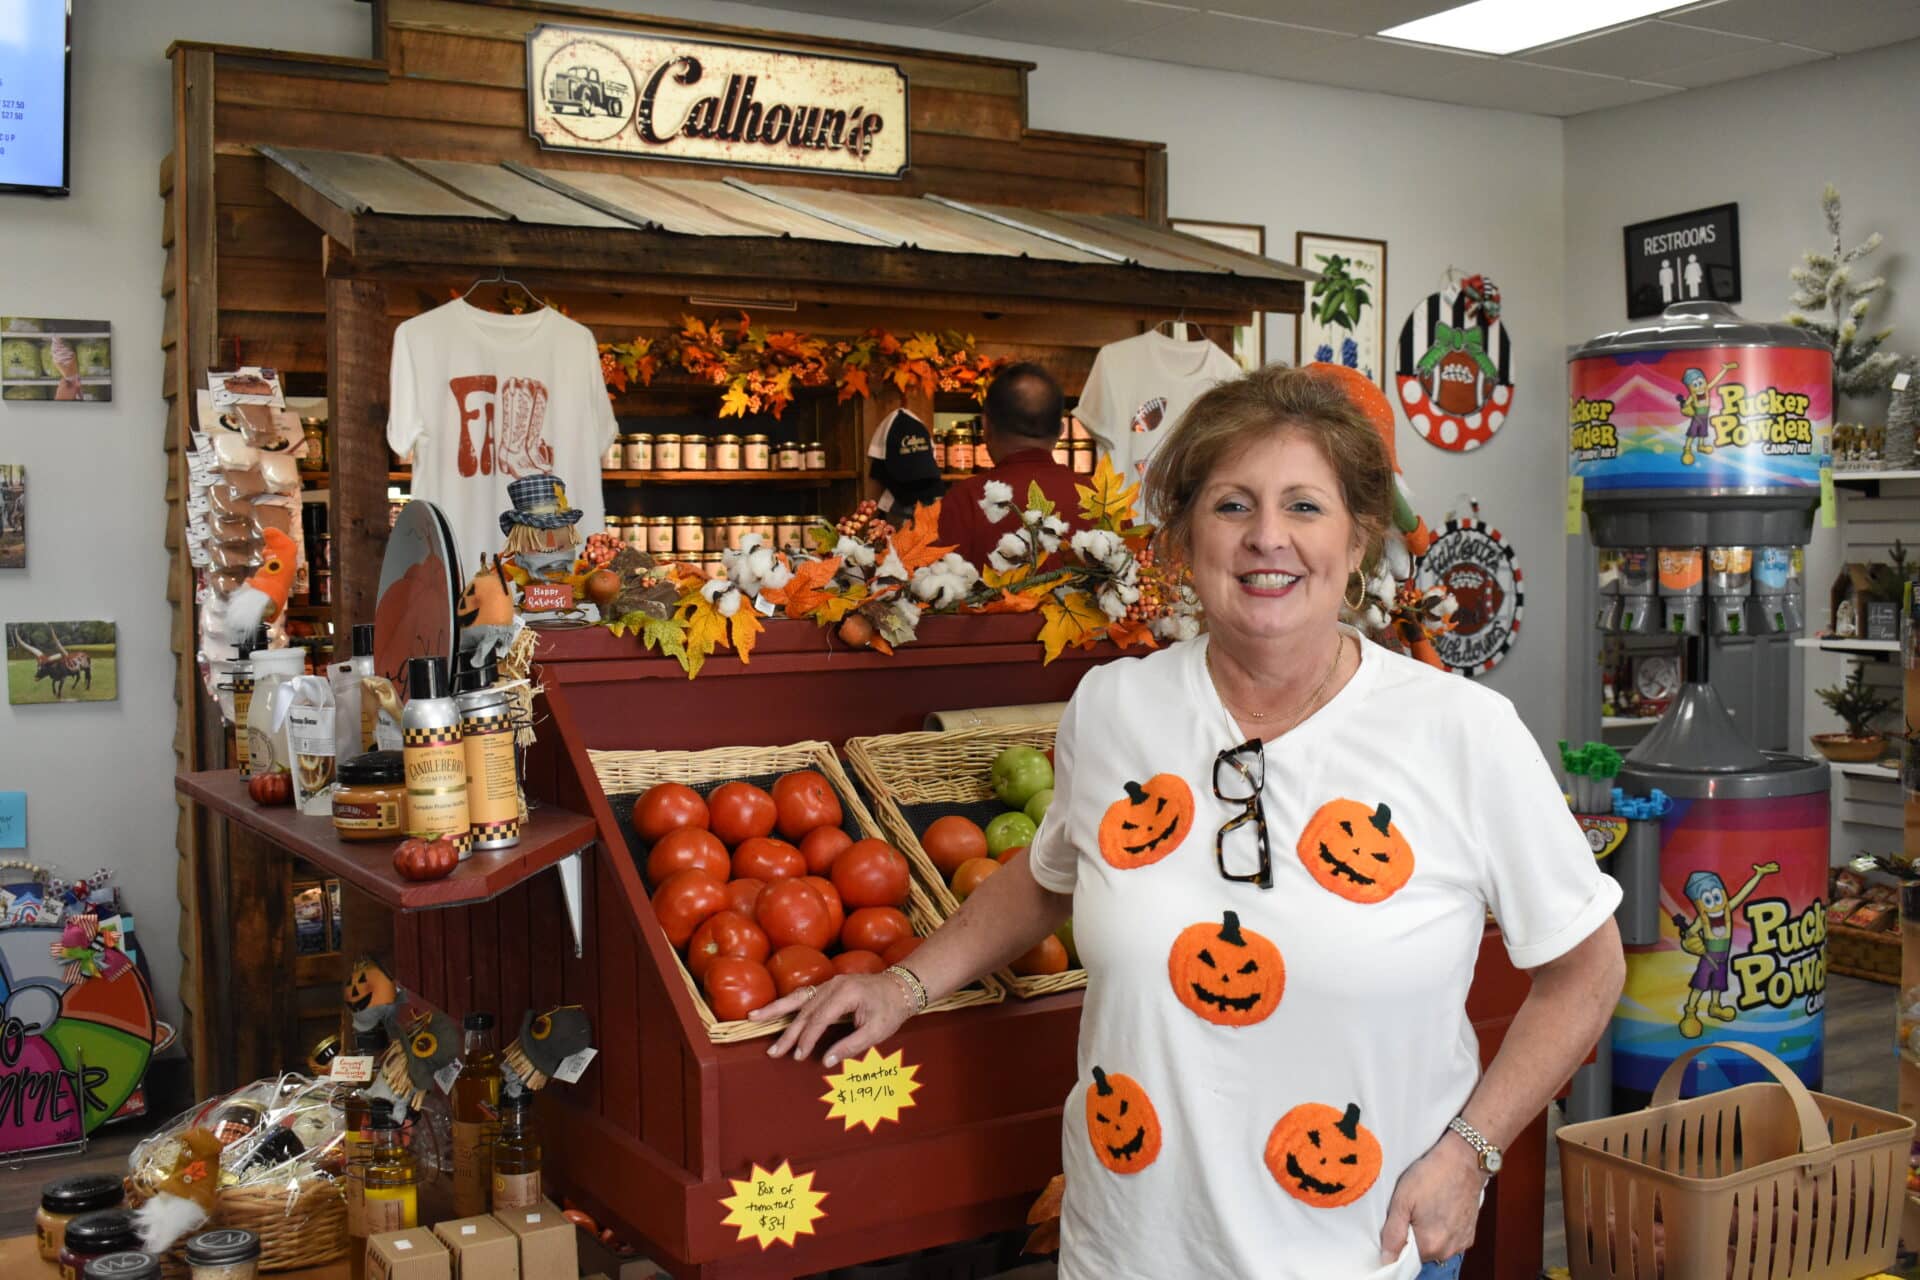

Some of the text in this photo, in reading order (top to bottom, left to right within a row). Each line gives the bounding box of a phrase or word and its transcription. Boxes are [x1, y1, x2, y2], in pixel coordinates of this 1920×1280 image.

[635, 54, 885, 158] Calhoun's
[1643, 223, 1716, 256] RESTROOMS
[1717, 383, 1810, 417] Pucker
[1744, 897, 1827, 957] Puck
[1732, 945, 1826, 1011] Powd
[846, 1065, 899, 1083] tomatoes
[744, 1198, 797, 1212] tomatoes
[757, 1181, 795, 1196] Box of
[759, 1214, 786, 1232] $34
